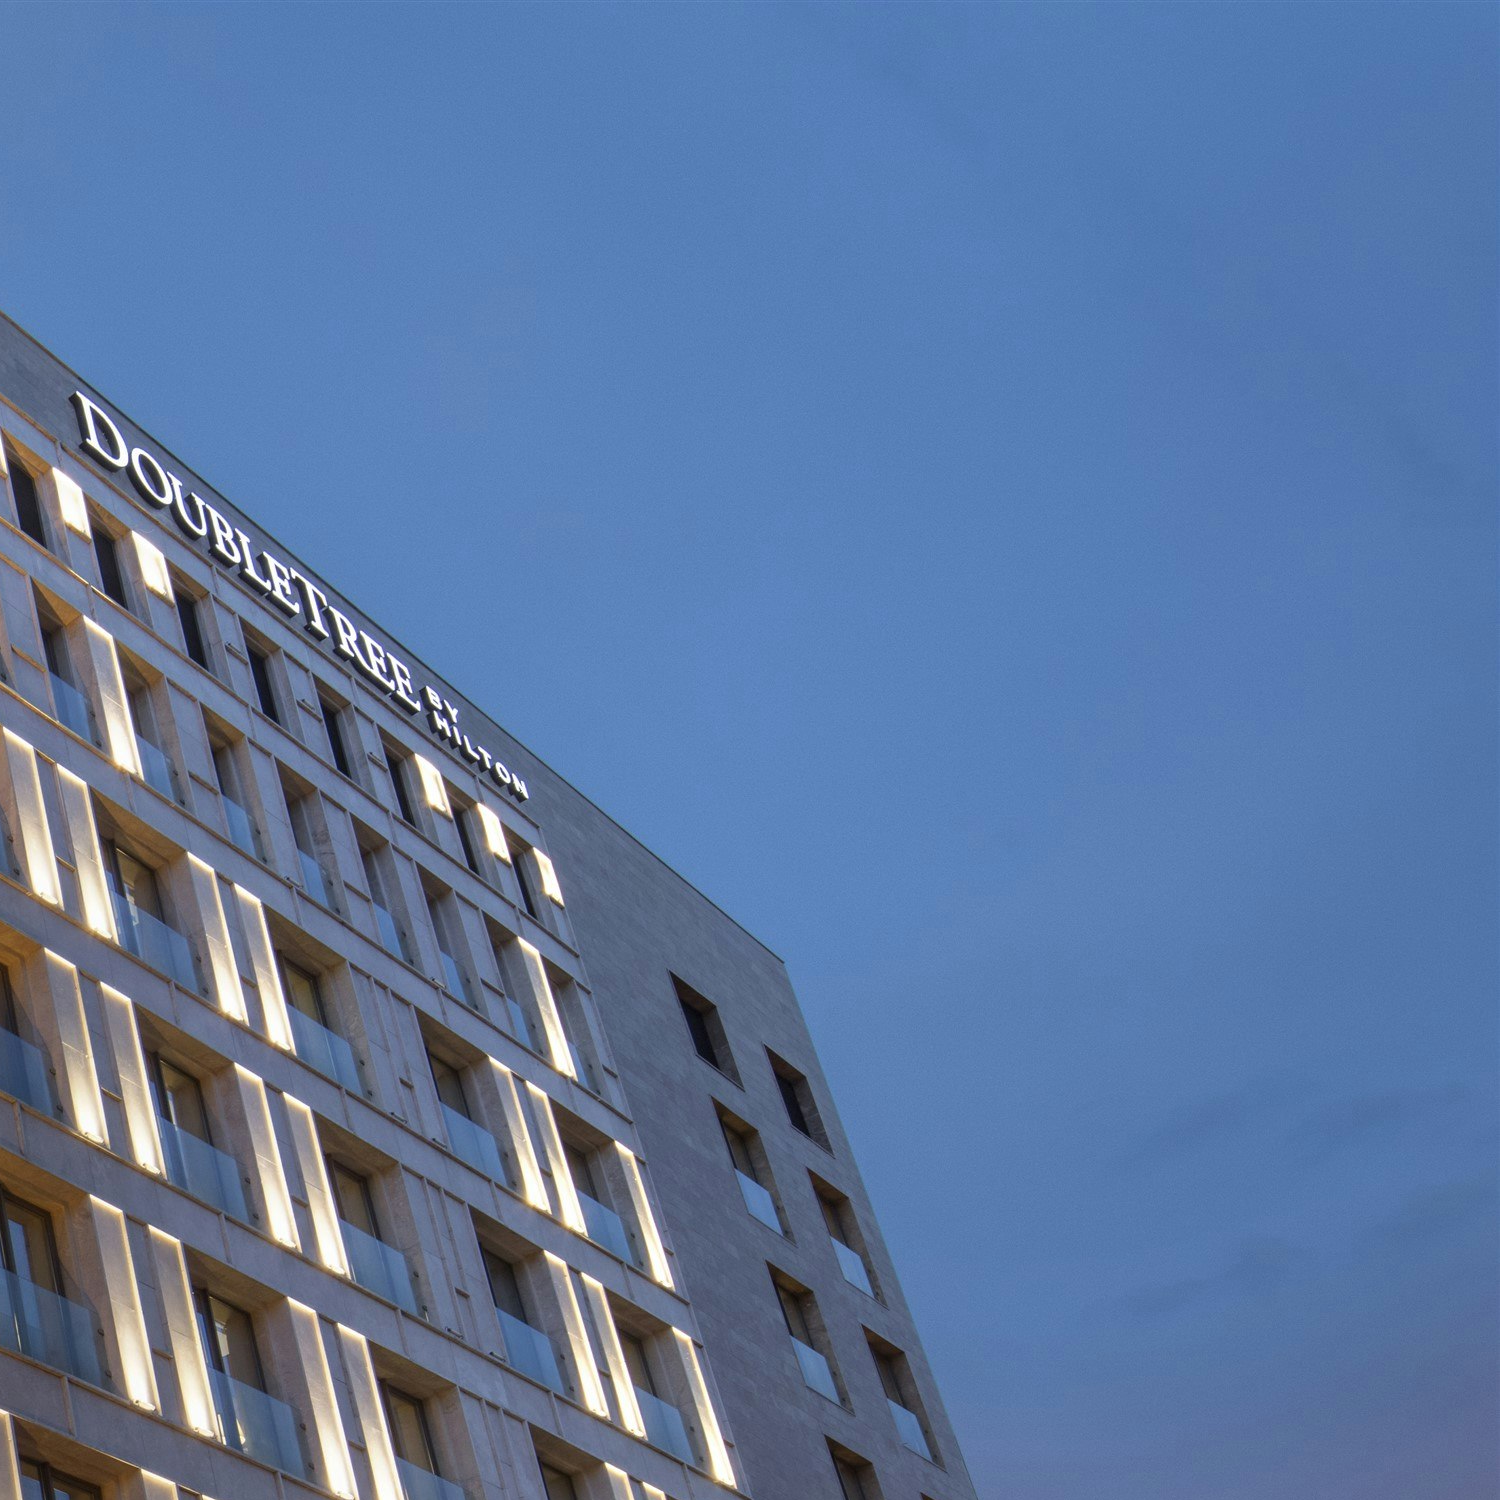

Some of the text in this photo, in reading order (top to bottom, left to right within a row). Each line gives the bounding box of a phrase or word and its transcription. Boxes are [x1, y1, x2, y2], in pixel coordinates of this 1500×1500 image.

[71, 391, 421, 714] DOUBLETREE
[422, 686, 458, 724] BY
[429, 711, 529, 802] HILTON
